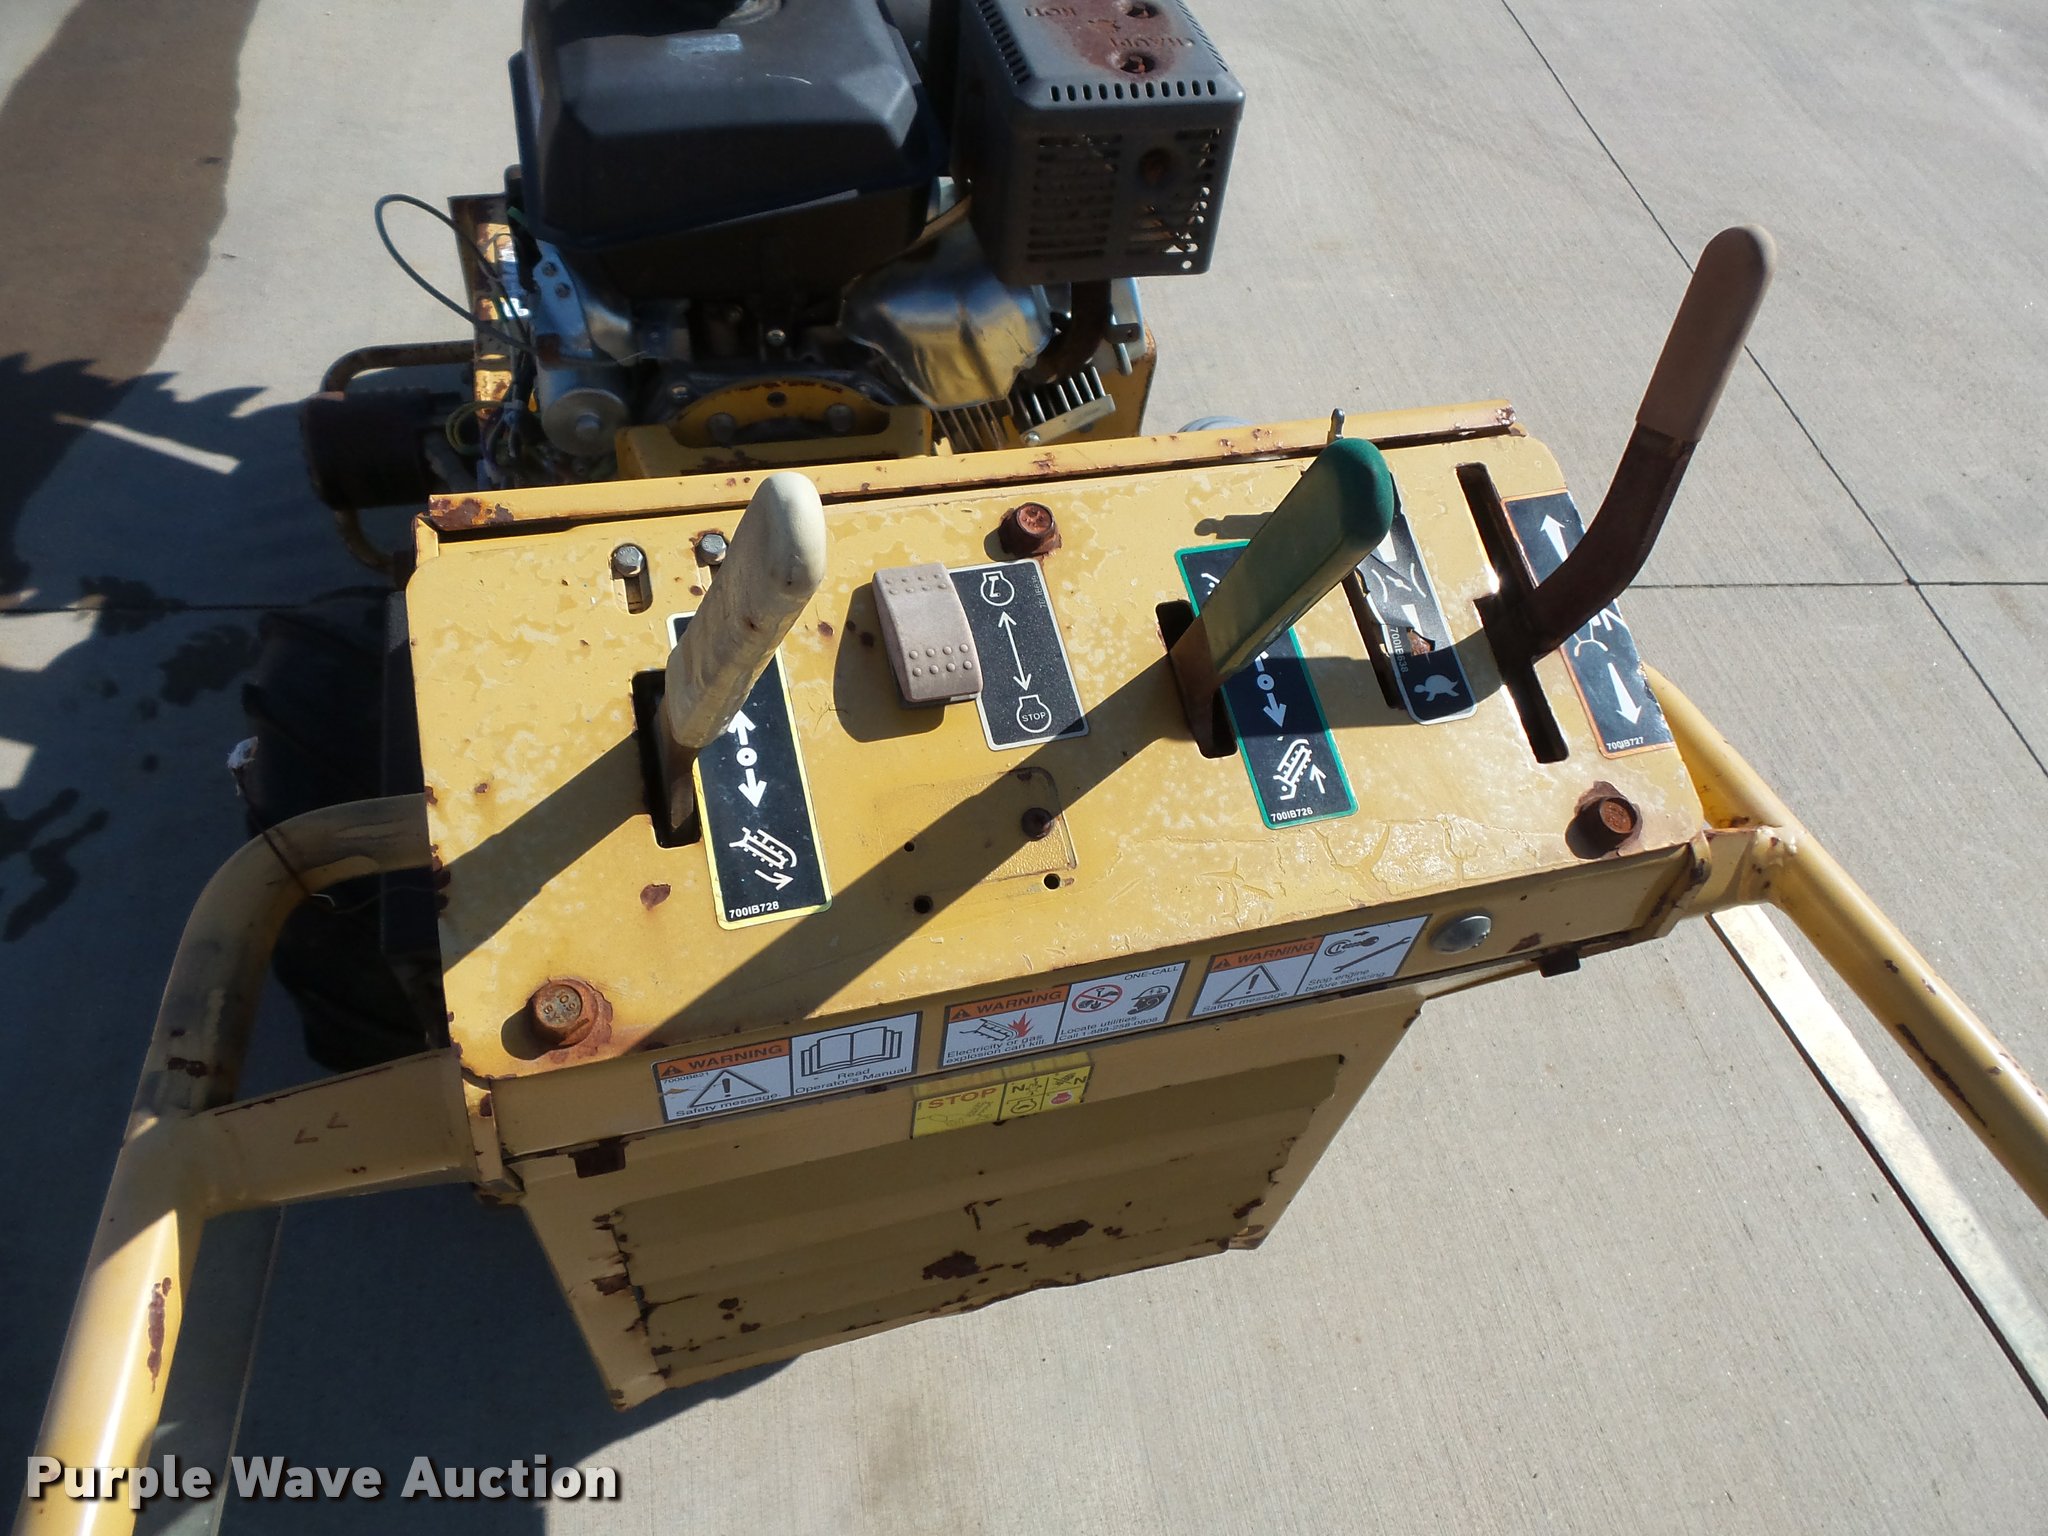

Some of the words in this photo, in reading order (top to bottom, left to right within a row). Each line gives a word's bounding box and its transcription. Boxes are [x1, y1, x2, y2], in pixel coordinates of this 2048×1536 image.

[1390, 627, 1408, 673] 700IB638
[1021, 711, 1046, 722] STOP
[1270, 807, 1313, 822] 700IB726
[729, 901, 779, 918] 700IB728
[1238, 942, 1314, 963] WARNING
[1124, 966, 1178, 980] ONE-CALL
[976, 991, 1062, 1014] WARNING
[1202, 1002, 1236, 1012] Safety
[1061, 1024, 1097, 1035] Locate
[1101, 1016, 1137, 1026] utilities
[1060, 1032, 1079, 1040] Call
[946, 1049, 1001, 1063] explosion
[1004, 1044, 1025, 1052] can
[947, 1042, 1003, 1058] Electricity
[1021, 1035, 1042, 1044] gas
[688, 1044, 783, 1071] WARNING
[837, 1068, 870, 1079] Read
[795, 1077, 859, 1093] Operator's
[675, 1104, 717, 1117] Safety
[720, 1093, 781, 1108] message.
[928, 1087, 997, 1109] STOP
